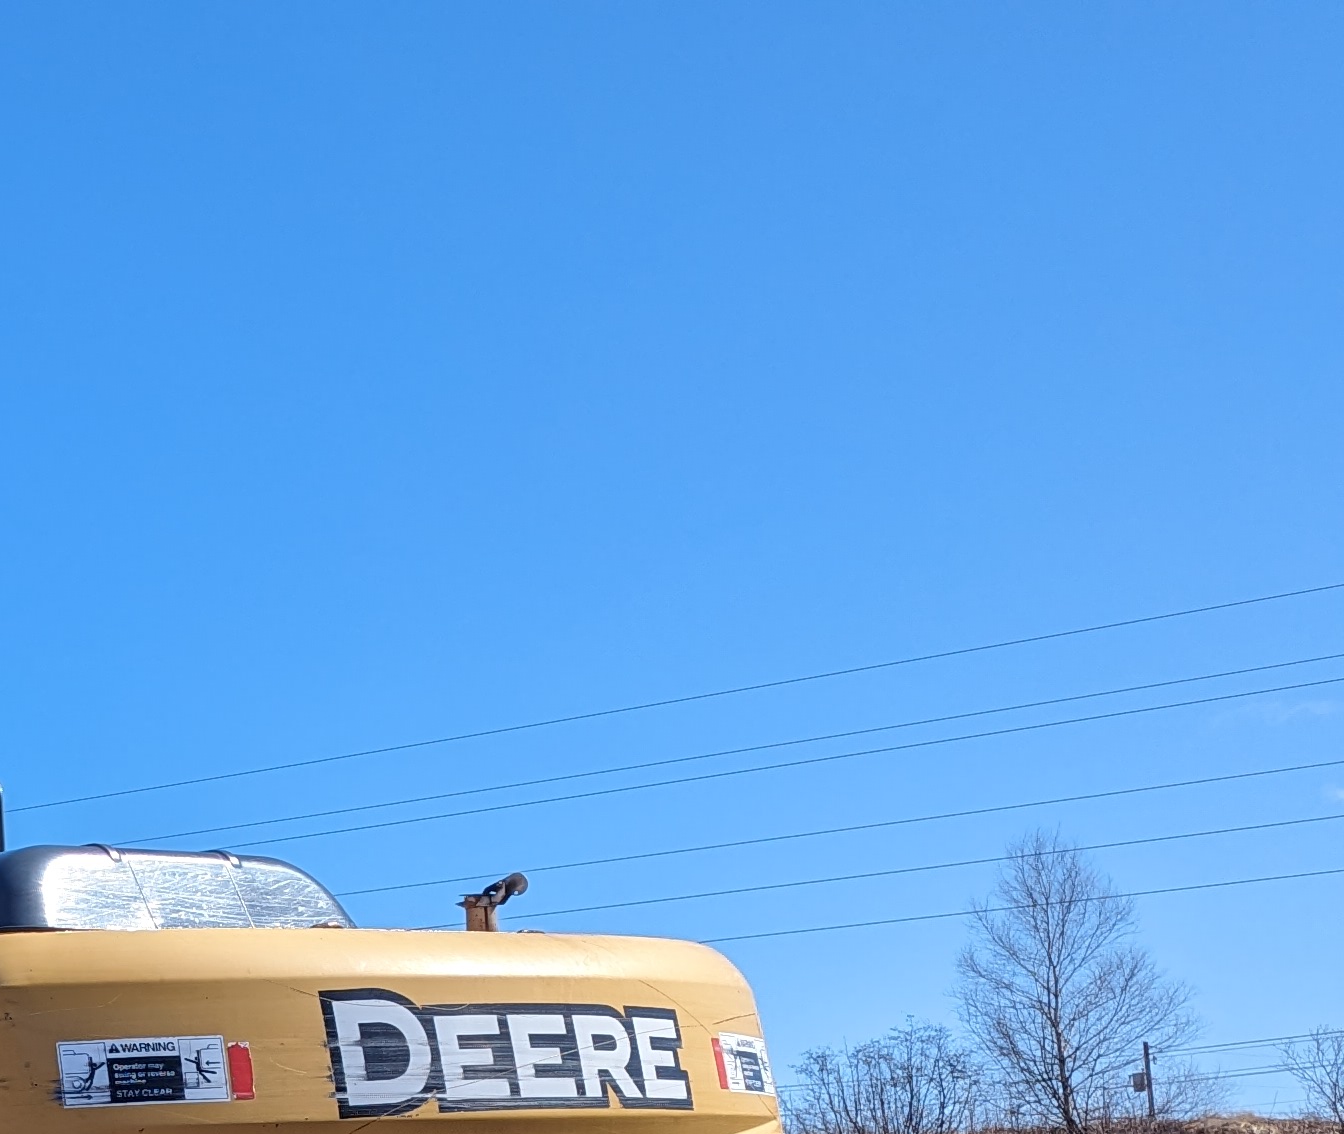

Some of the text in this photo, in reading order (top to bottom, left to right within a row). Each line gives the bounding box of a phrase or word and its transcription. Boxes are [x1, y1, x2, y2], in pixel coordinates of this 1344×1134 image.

[120, 1042, 176, 1053] WARNING
[328, 996, 690, 1109] DEERE
[113, 1063, 147, 1071] Operator
[116, 1087, 173, 1098] STAY CLEAR
